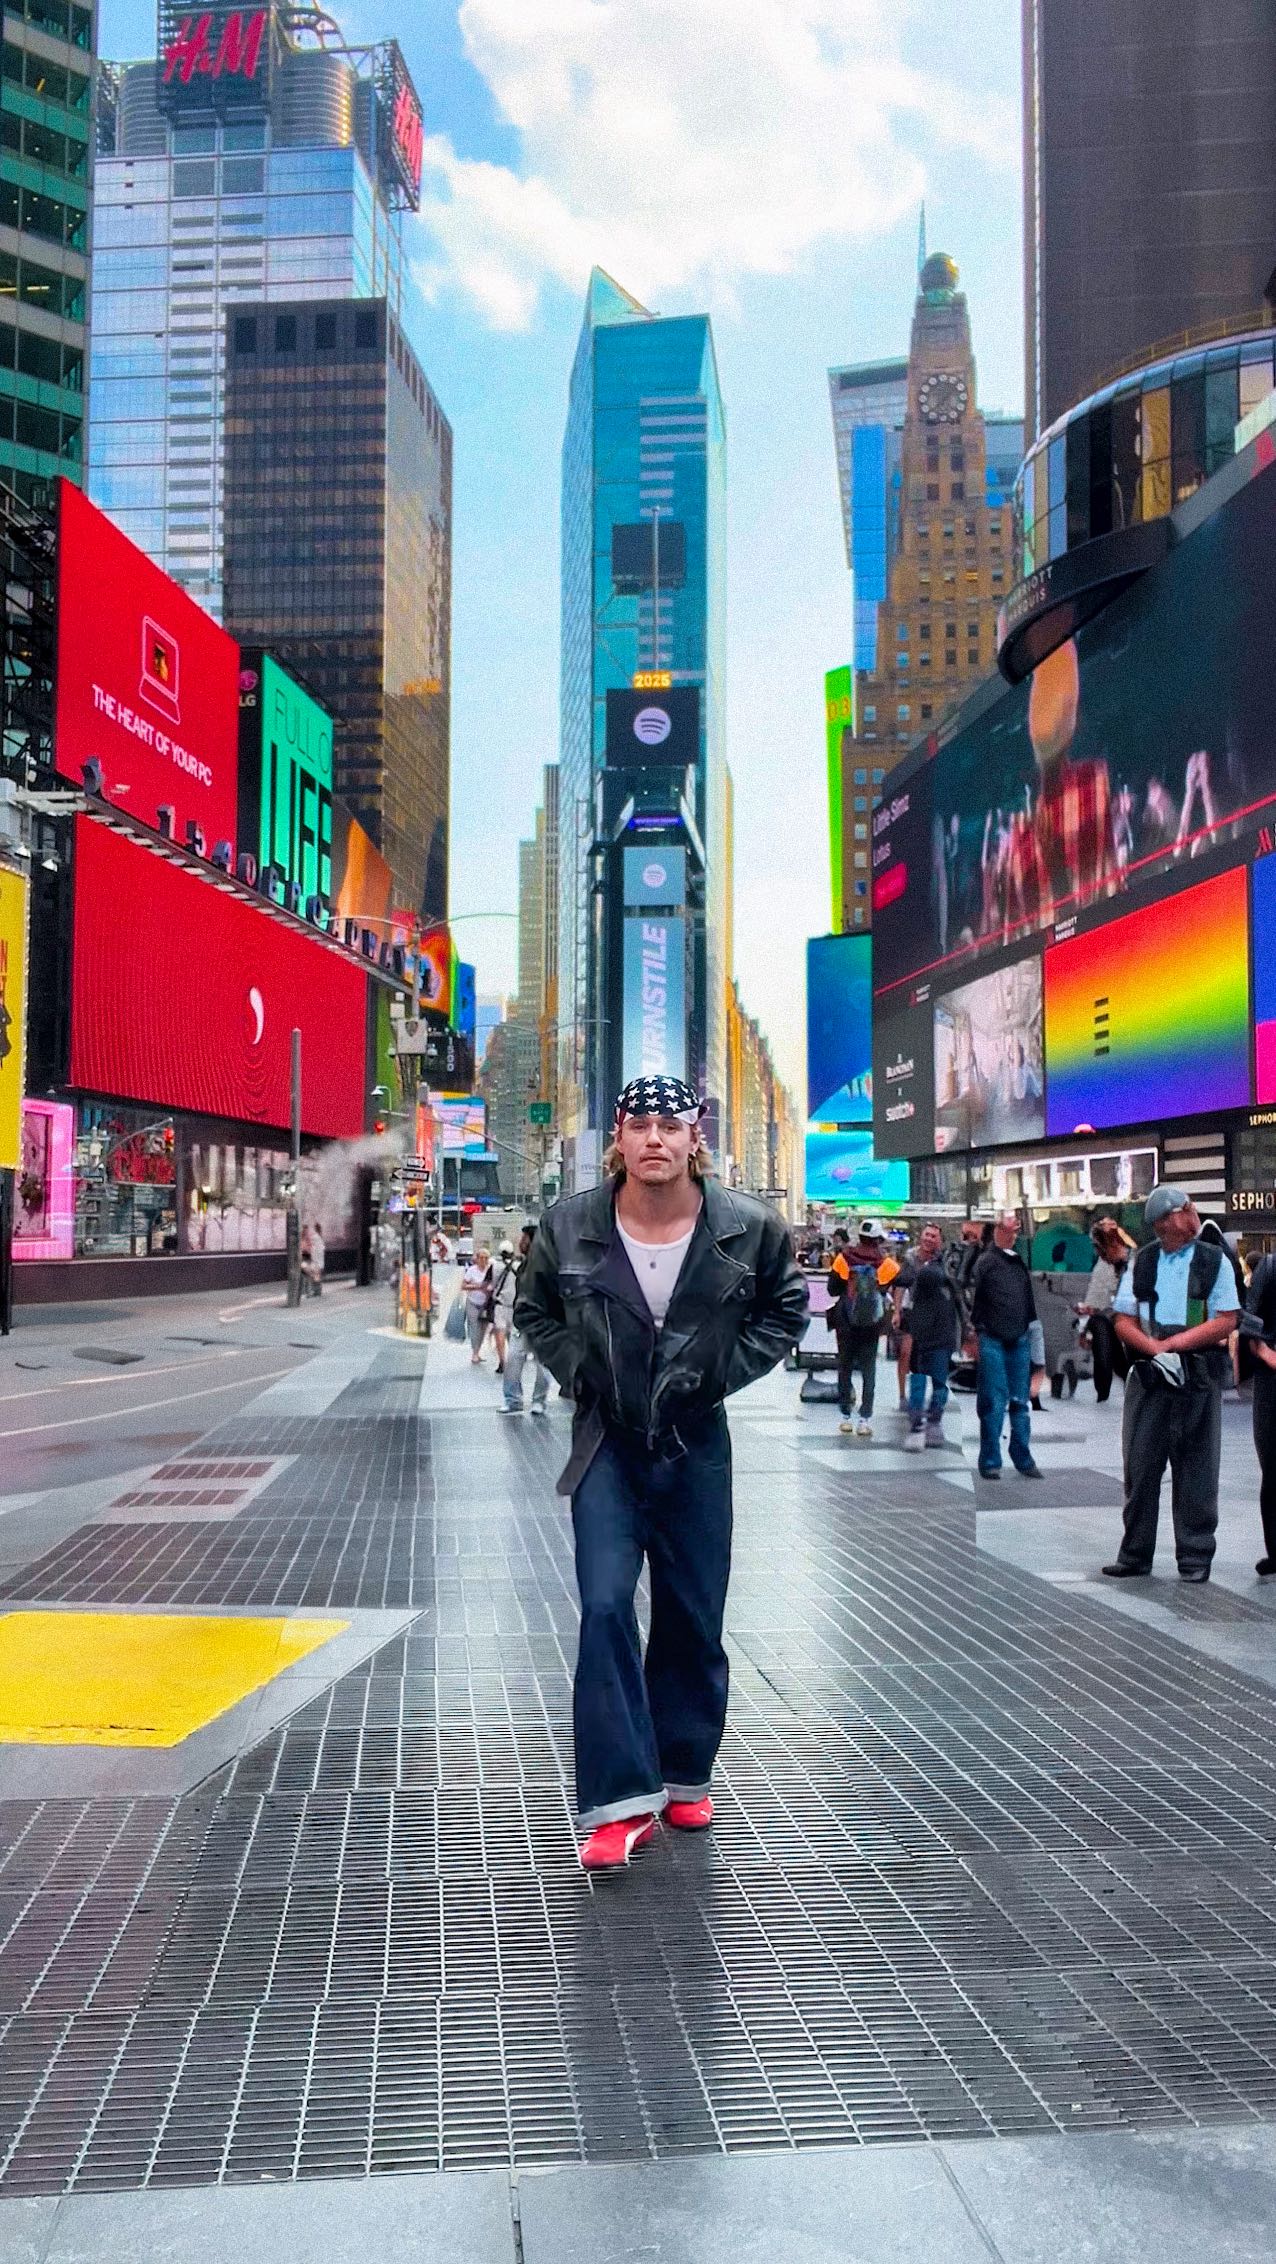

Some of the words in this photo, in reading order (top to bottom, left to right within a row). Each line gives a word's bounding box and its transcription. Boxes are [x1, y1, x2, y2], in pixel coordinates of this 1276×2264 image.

[162, 8, 268, 85] H&M
[238, 694, 256, 707] LG
[633, 674, 671, 687] 2025
[92, 684, 116, 720] THE
[117, 702, 154, 746] HEART
[155, 731, 171, 755] OF
[170, 742, 198, 777] YOUR
[198, 761, 213, 787] PC
[275, 688, 315, 764] FULL
